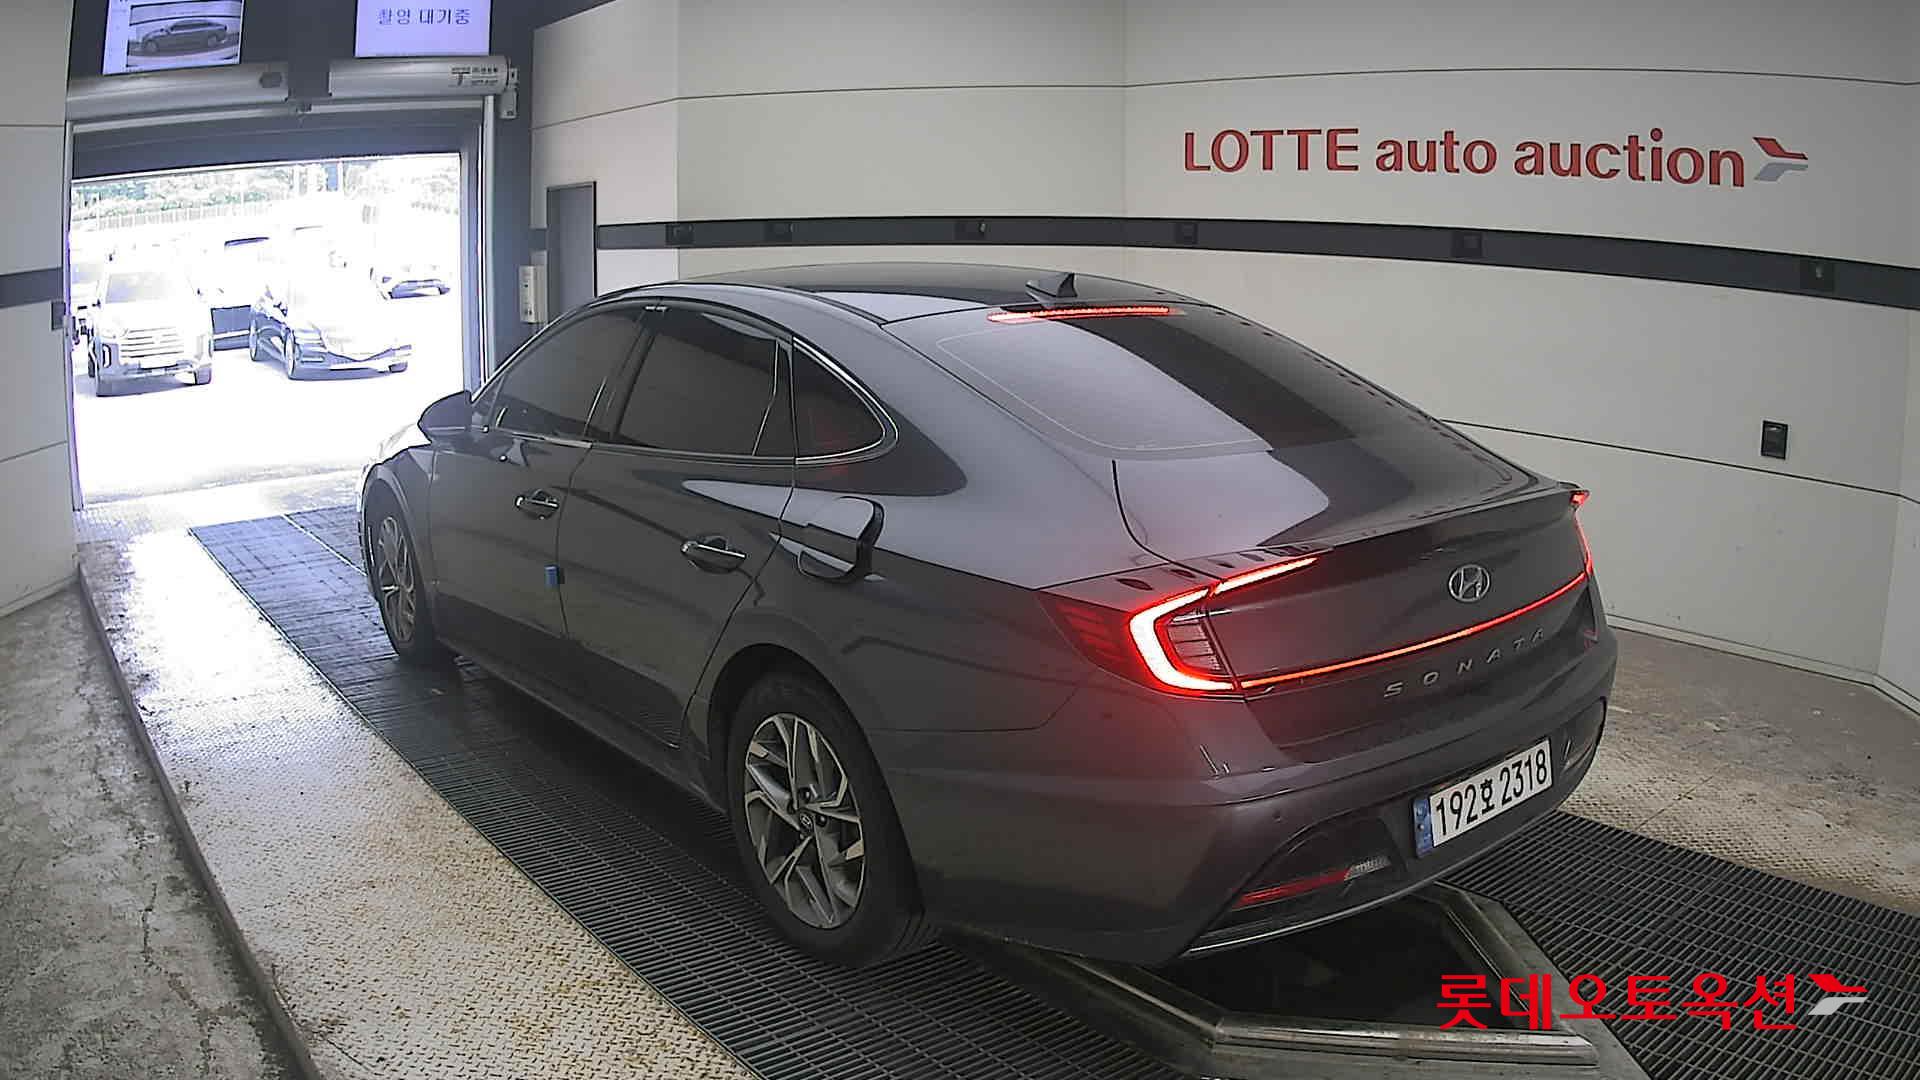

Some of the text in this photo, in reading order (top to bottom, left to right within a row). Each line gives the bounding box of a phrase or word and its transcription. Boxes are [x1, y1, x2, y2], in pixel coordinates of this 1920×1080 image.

[420, 8, 470, 25] 대기중
[1184, 128, 1745, 187] LOTTE auto auction
[1383, 628, 1546, 698] SONATA
[1499, 748, 1548, 807] 2318
